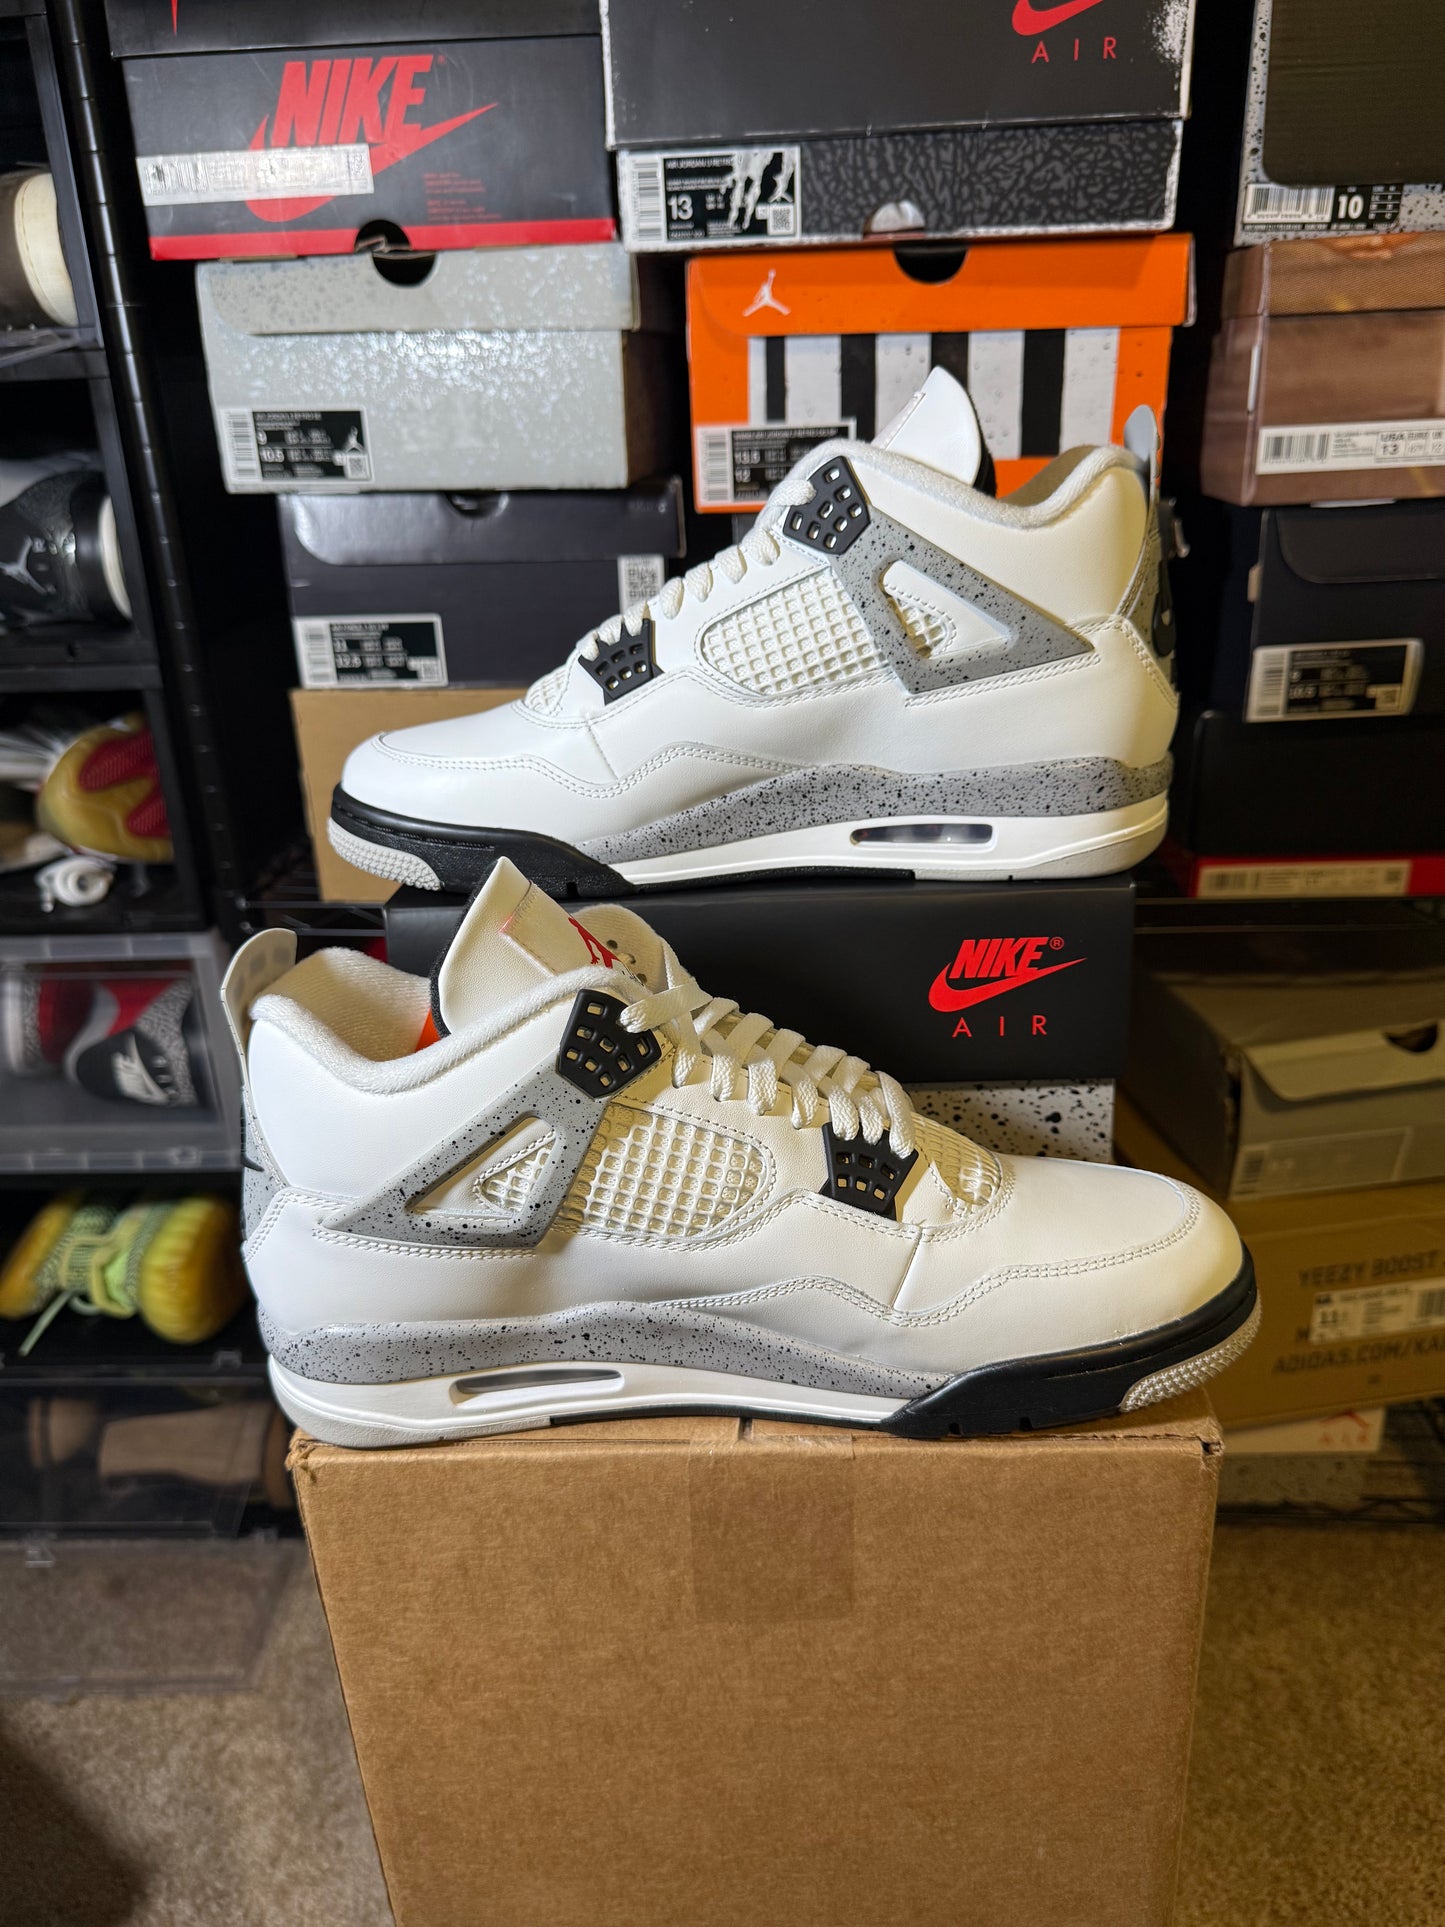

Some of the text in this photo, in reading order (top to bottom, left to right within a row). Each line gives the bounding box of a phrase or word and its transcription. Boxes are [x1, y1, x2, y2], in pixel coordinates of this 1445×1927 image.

[1031, 36, 1117, 63] AIR
[271, 55, 434, 147] NIKE
[667, 193, 694, 221] 13
[1338, 194, 1364, 220] 10
[949, 936, 1049, 979] NIKE
[952, 1015, 1047, 1038] AIR
[1299, 1250, 1438, 1287] YEEZY BOOST
